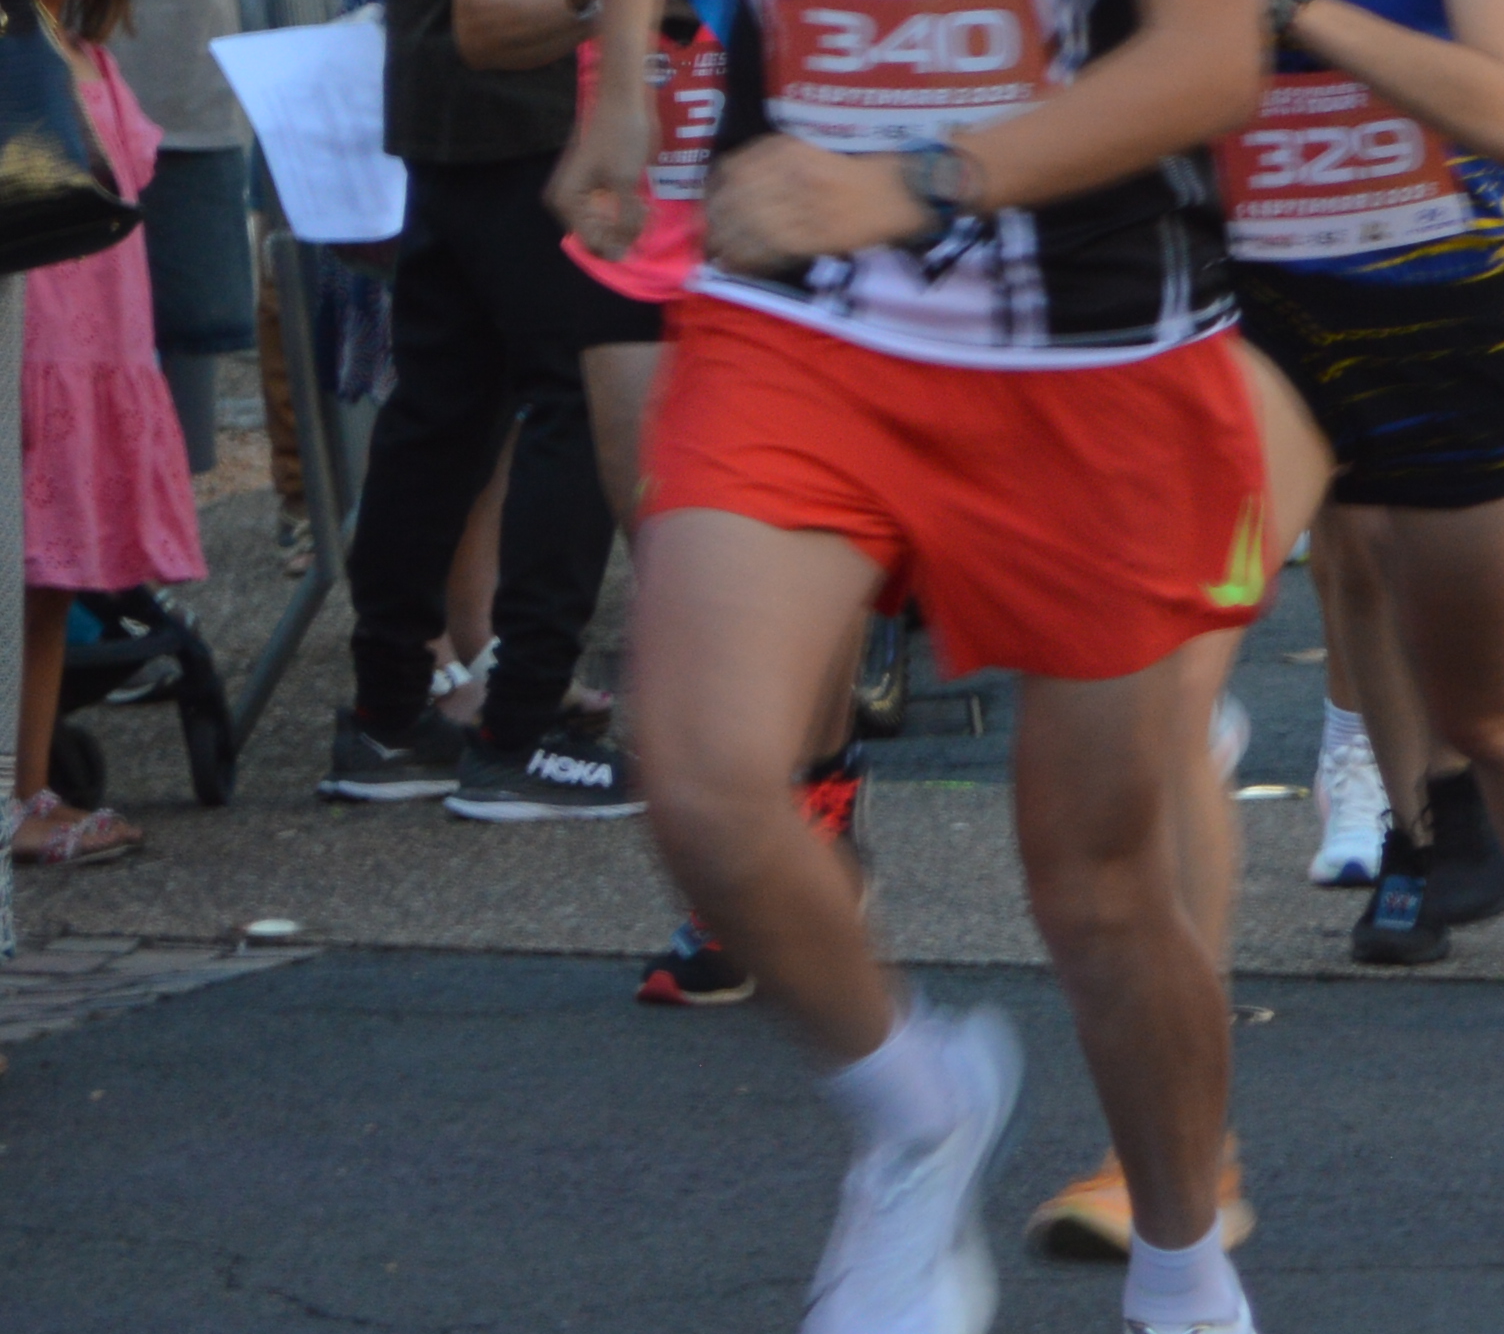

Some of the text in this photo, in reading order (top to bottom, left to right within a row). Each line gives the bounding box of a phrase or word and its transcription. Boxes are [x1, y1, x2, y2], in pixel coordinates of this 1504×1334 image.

[802, 8, 1023, 74] 340
[1240, 117, 1426, 190] 329
[526, 748, 614, 789] HOKA
